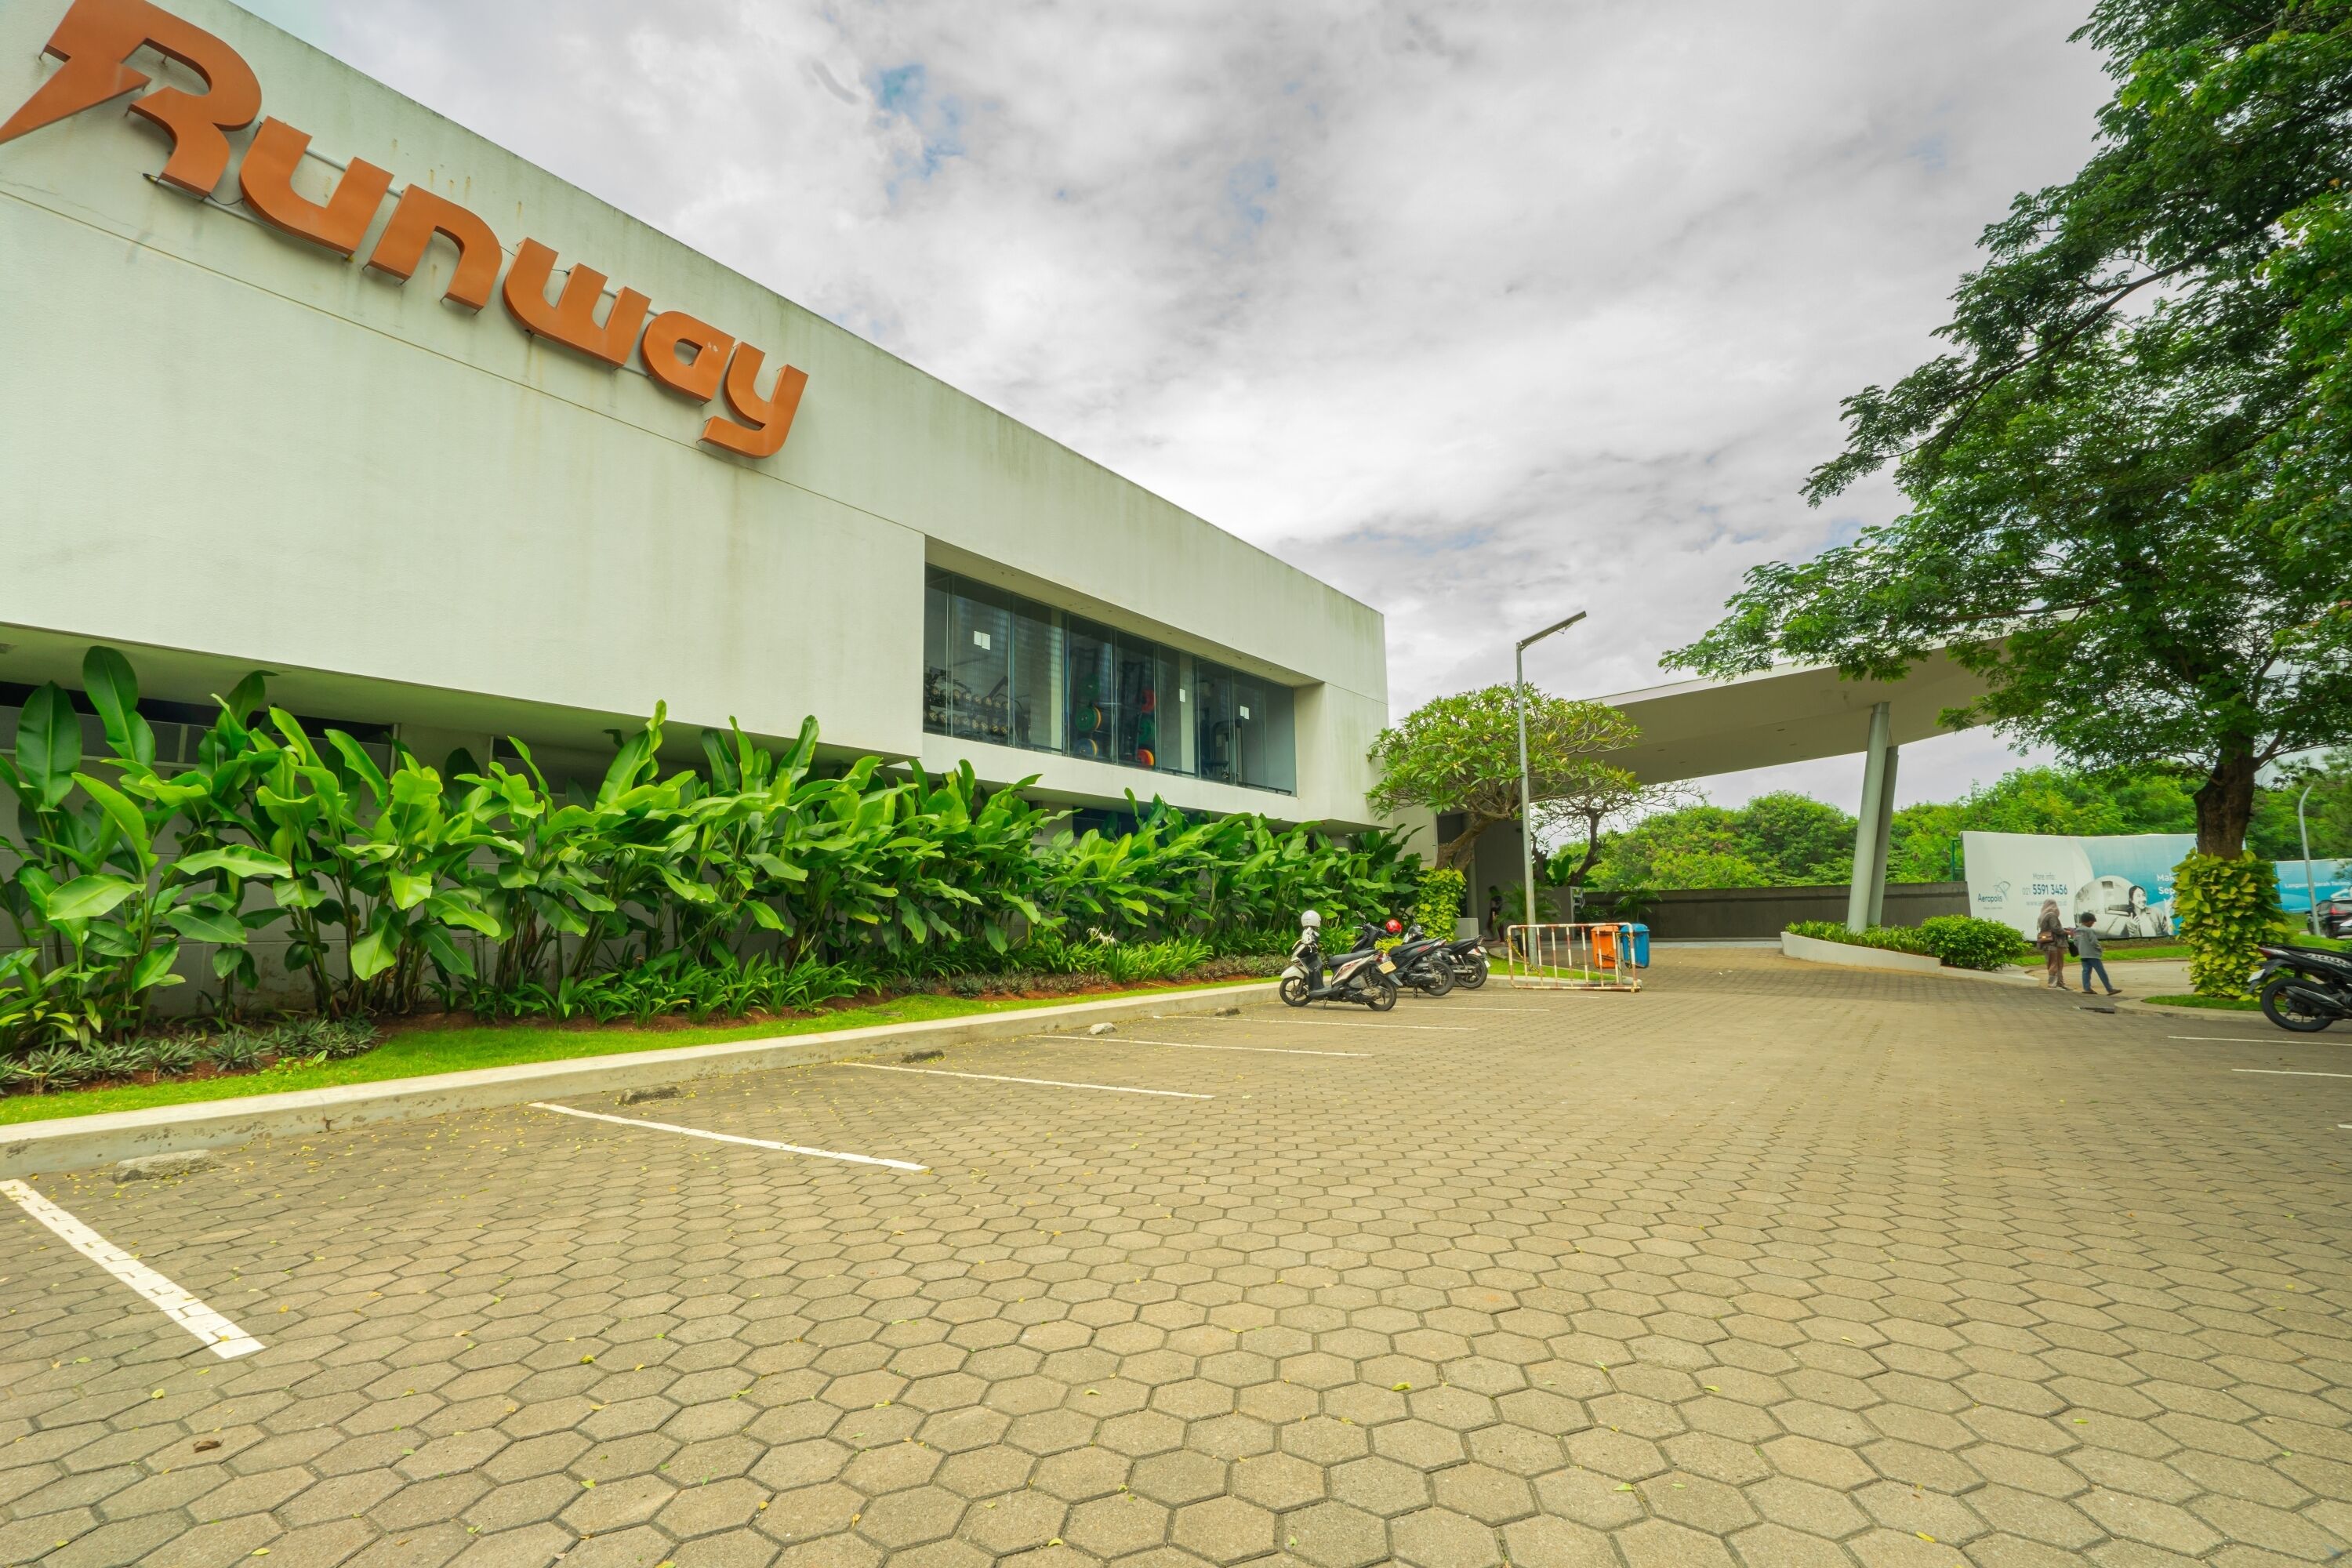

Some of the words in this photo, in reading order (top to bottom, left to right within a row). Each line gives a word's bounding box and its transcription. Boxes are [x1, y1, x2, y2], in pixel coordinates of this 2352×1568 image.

[0, 0, 808, 459] Runway
[2032, 884, 2049, 895] 5591
[2051, 884, 2067, 895] 3456
[1977, 893, 2002, 903] Aeropolis
